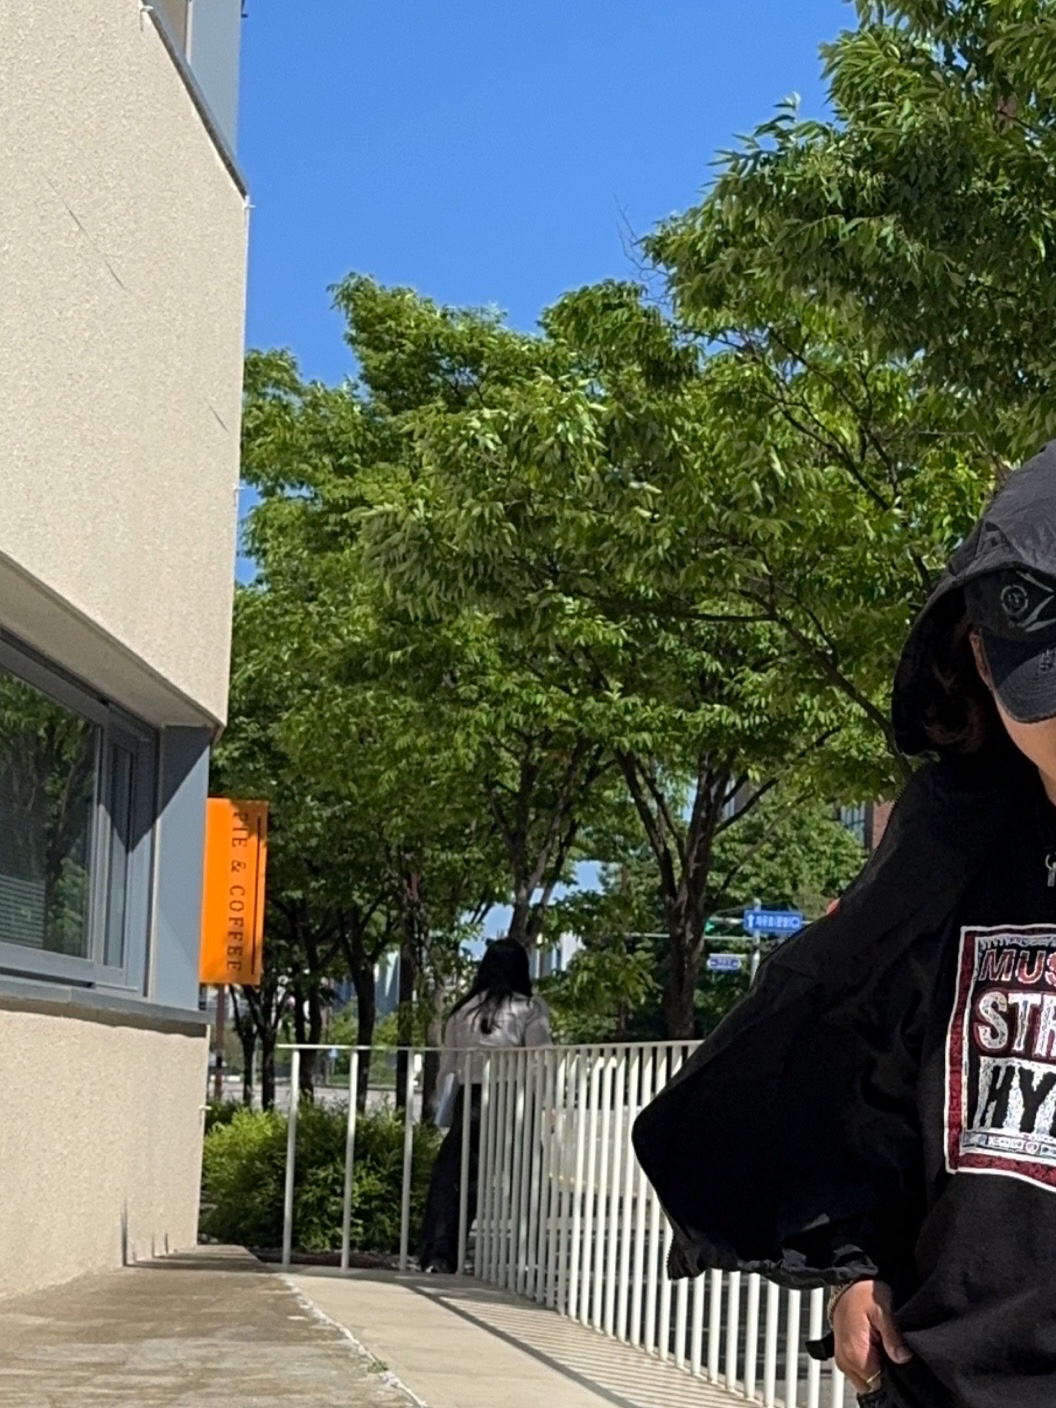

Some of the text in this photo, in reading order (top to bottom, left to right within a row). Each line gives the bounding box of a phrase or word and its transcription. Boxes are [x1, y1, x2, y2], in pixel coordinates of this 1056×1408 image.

[226, 811, 248, 972] PIE & COFFEE
